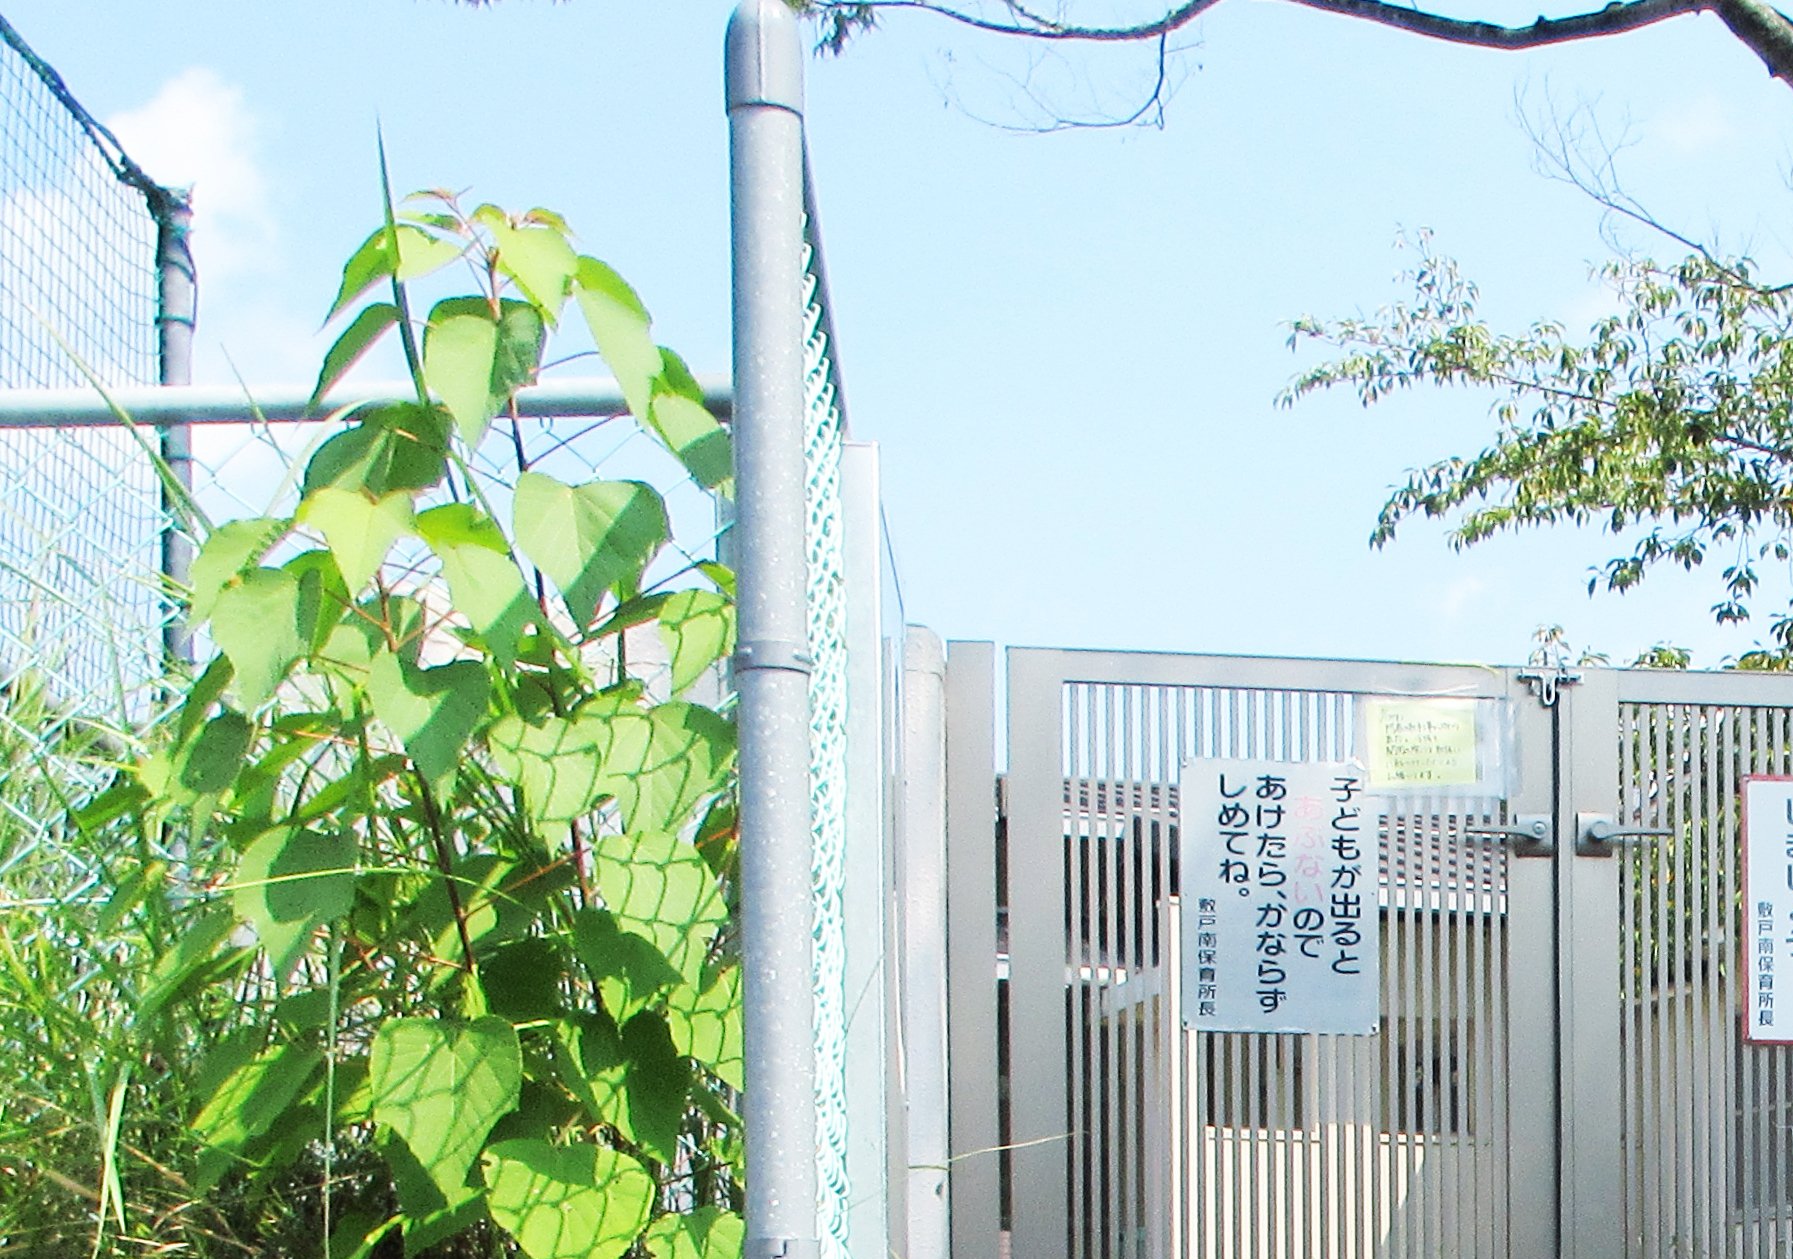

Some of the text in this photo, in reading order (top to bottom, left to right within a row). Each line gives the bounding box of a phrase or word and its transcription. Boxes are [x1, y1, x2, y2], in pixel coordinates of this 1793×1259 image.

[1218, 774, 1250, 898] しめてね。
[1256, 774, 1287, 1014] あけたら、かならず
[1331, 777, 1361, 975] 子どもが出ると
[1757, 901, 1774, 1027] 敷戸南保育所長
